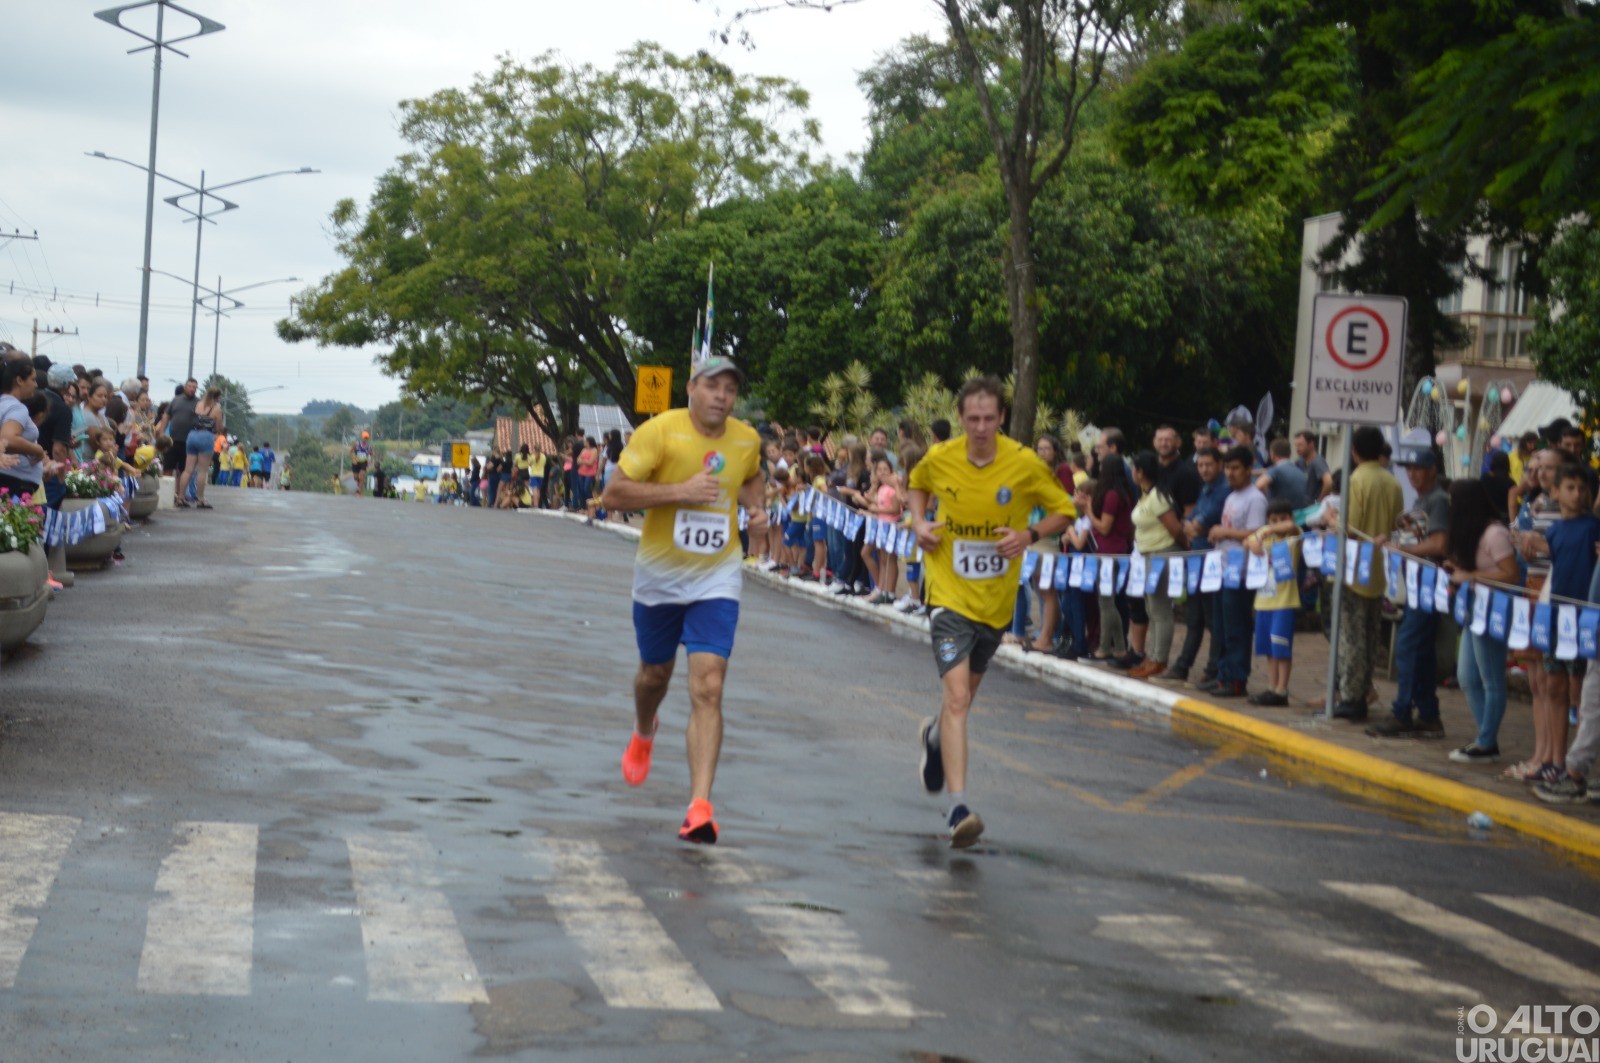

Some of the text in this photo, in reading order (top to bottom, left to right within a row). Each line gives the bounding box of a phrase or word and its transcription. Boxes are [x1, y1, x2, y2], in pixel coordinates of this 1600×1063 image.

[1346, 321, 1369, 356] E
[1315, 378, 1393, 396] EXCLUSIVO
[680, 526, 725, 549] 105
[959, 554, 1004, 574] 169
